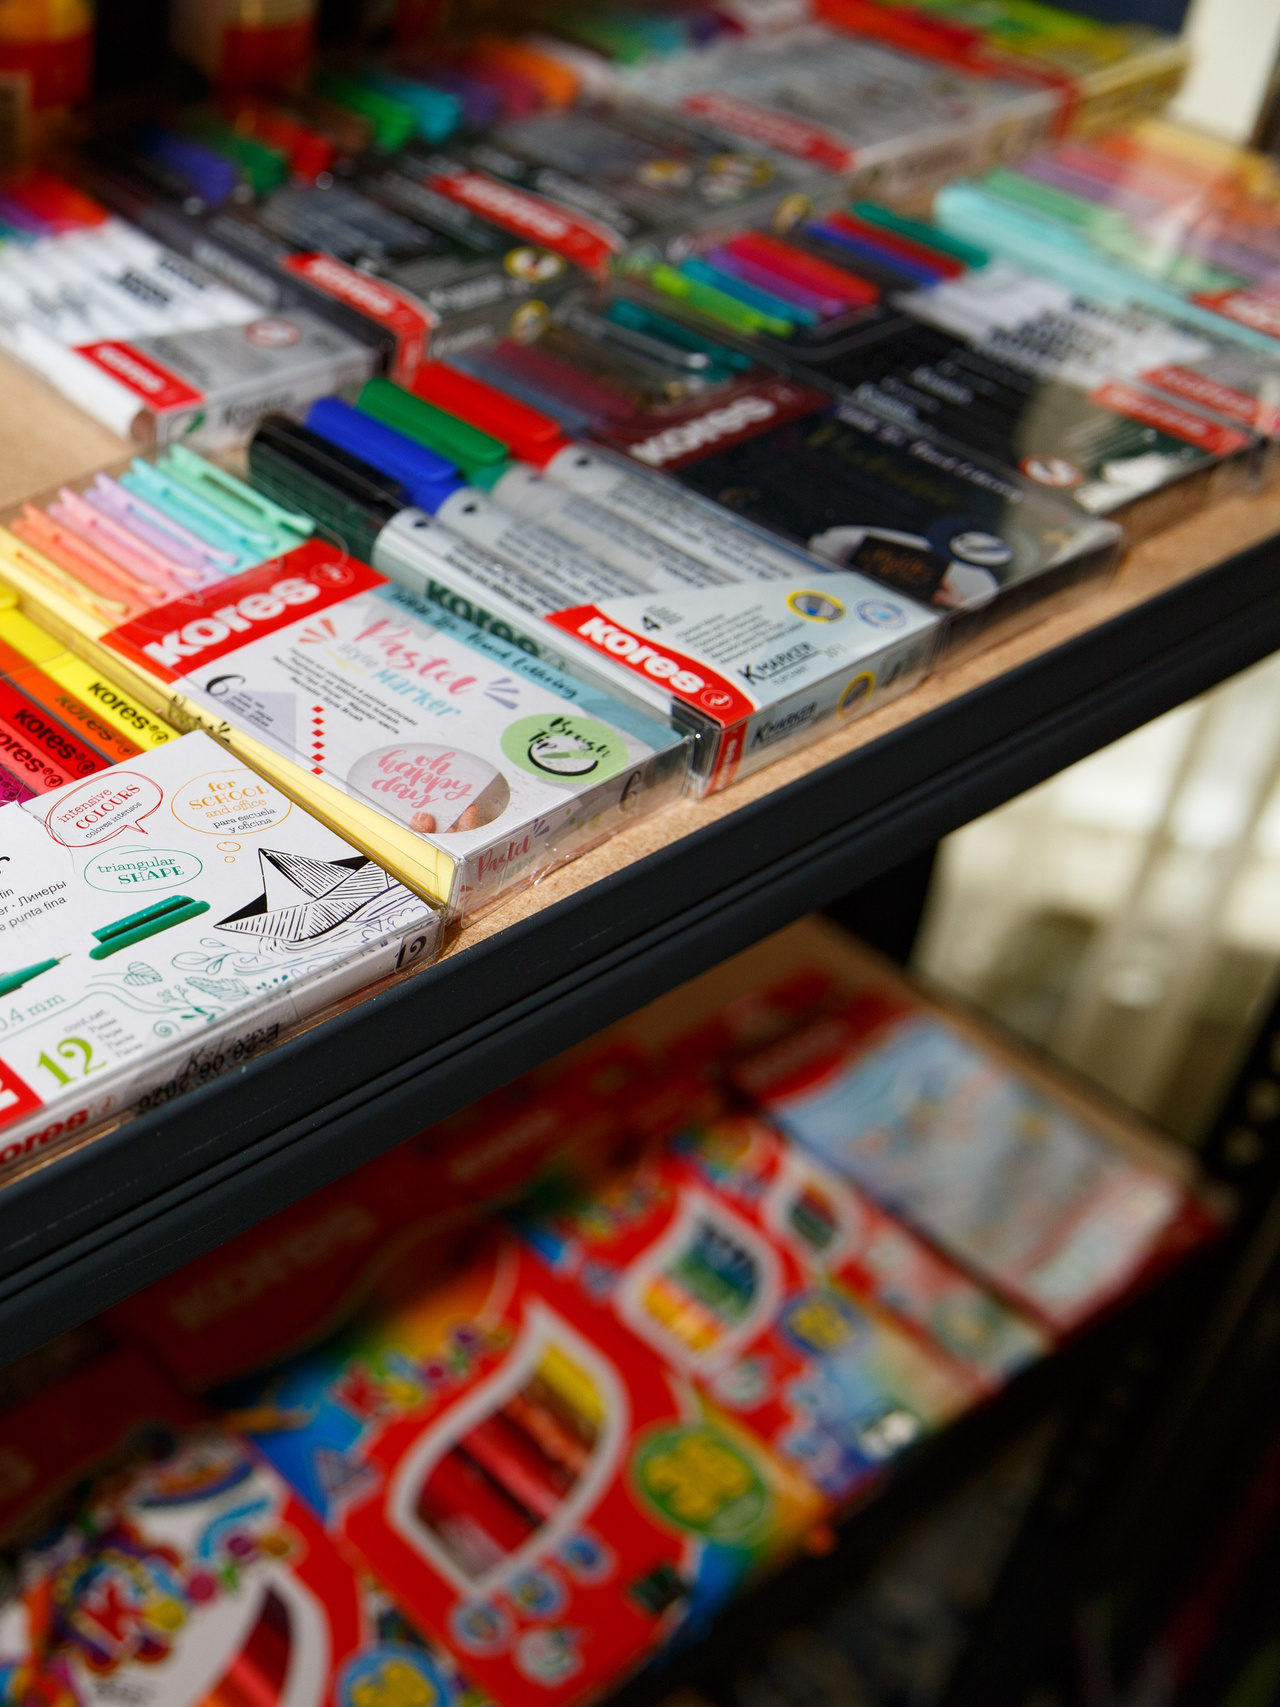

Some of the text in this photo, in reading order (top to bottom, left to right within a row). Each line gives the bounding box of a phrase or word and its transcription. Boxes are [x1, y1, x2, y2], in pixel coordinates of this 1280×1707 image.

[142, 577, 321, 667] Kores
[642, 615, 662, 632] 4
[353, 618, 478, 694] Pastel
[577, 615, 705, 695] Kores
[205, 674, 247, 697] 6
[88, 681, 152, 730] Kores
[13, 707, 79, 760] Kores
[529, 728, 558, 751] Tip
[550, 717, 611, 758] Brush
[376, 749, 473, 801] happy
[415, 751, 456, 776] oh
[188, 784, 270, 811] SCHOOL
[206, 778, 236, 793] for
[371, 776, 439, 809] day
[56, 787, 113, 824] intensive
[75, 783, 141, 831] COLOURS
[84, 801, 143, 840] colores intensos
[205, 798, 268, 819] and office
[211, 807, 277, 830] para escuela
[228, 817, 273, 834] y oficina
[97, 855, 177, 874] triangular
[118, 865, 185, 885] SHAPE
[18, 880, 67, 908] Линеры
[8, 907, 44, 929] punta
[44, 896, 67, 911] fina
[394, 935, 427, 970] 12
[27, 992, 67, 1017] mm
[37, 1037, 108, 1089] 12
